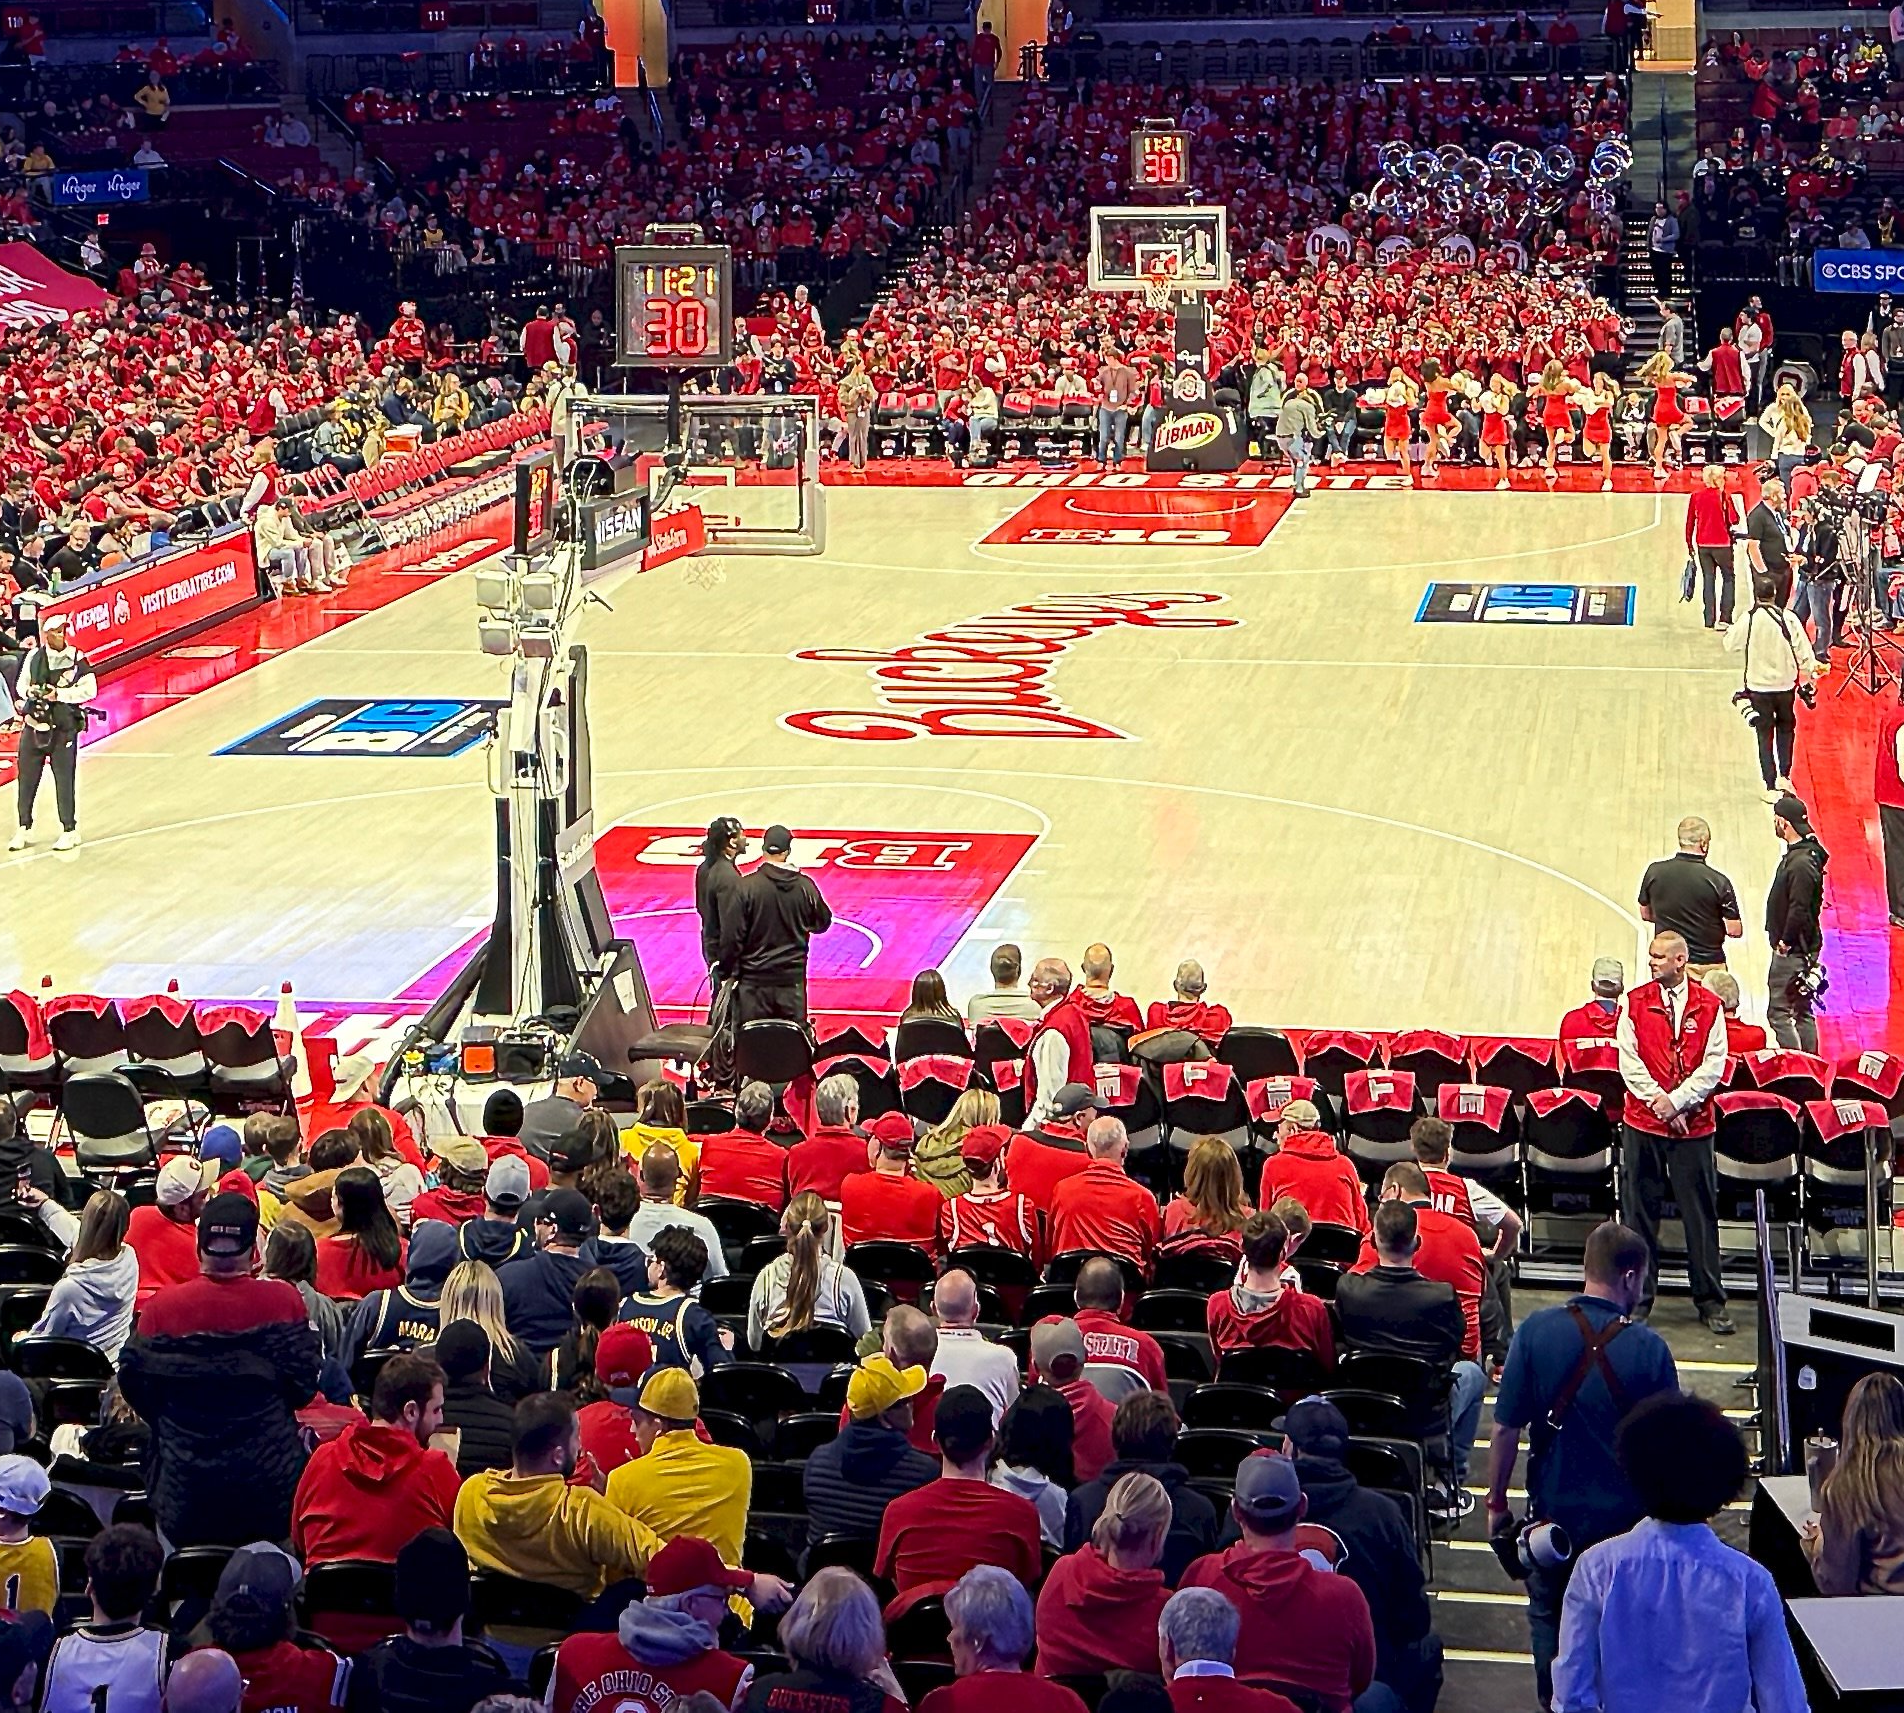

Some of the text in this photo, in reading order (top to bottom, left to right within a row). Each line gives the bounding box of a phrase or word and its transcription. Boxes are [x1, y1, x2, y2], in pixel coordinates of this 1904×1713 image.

[428, 10, 445, 22] 111
[815, 4, 832, 15] 111
[1145, 136, 1182, 153] 11:21
[1145, 154, 1178, 182] 30
[62, 174, 141, 202] Kroger Kroger
[643, 265, 714, 296] 11:21
[1838, 263, 1872, 281] CBS
[644, 298, 707, 357] 30
[1154, 420, 1215, 448] LIBMAN
[963, 472, 1152, 487] OHIO
[595, 506, 642, 546] NISSAN
[75, 602, 110, 631] KENDA
[140, 591, 167, 616] VISIT
[166, 561, 238, 605] KENDATIRE.COM
[398, 1320, 436, 1341] MARA
[5, 1572, 21, 1610] 1
[601, 1669, 653, 1694] OHIO
